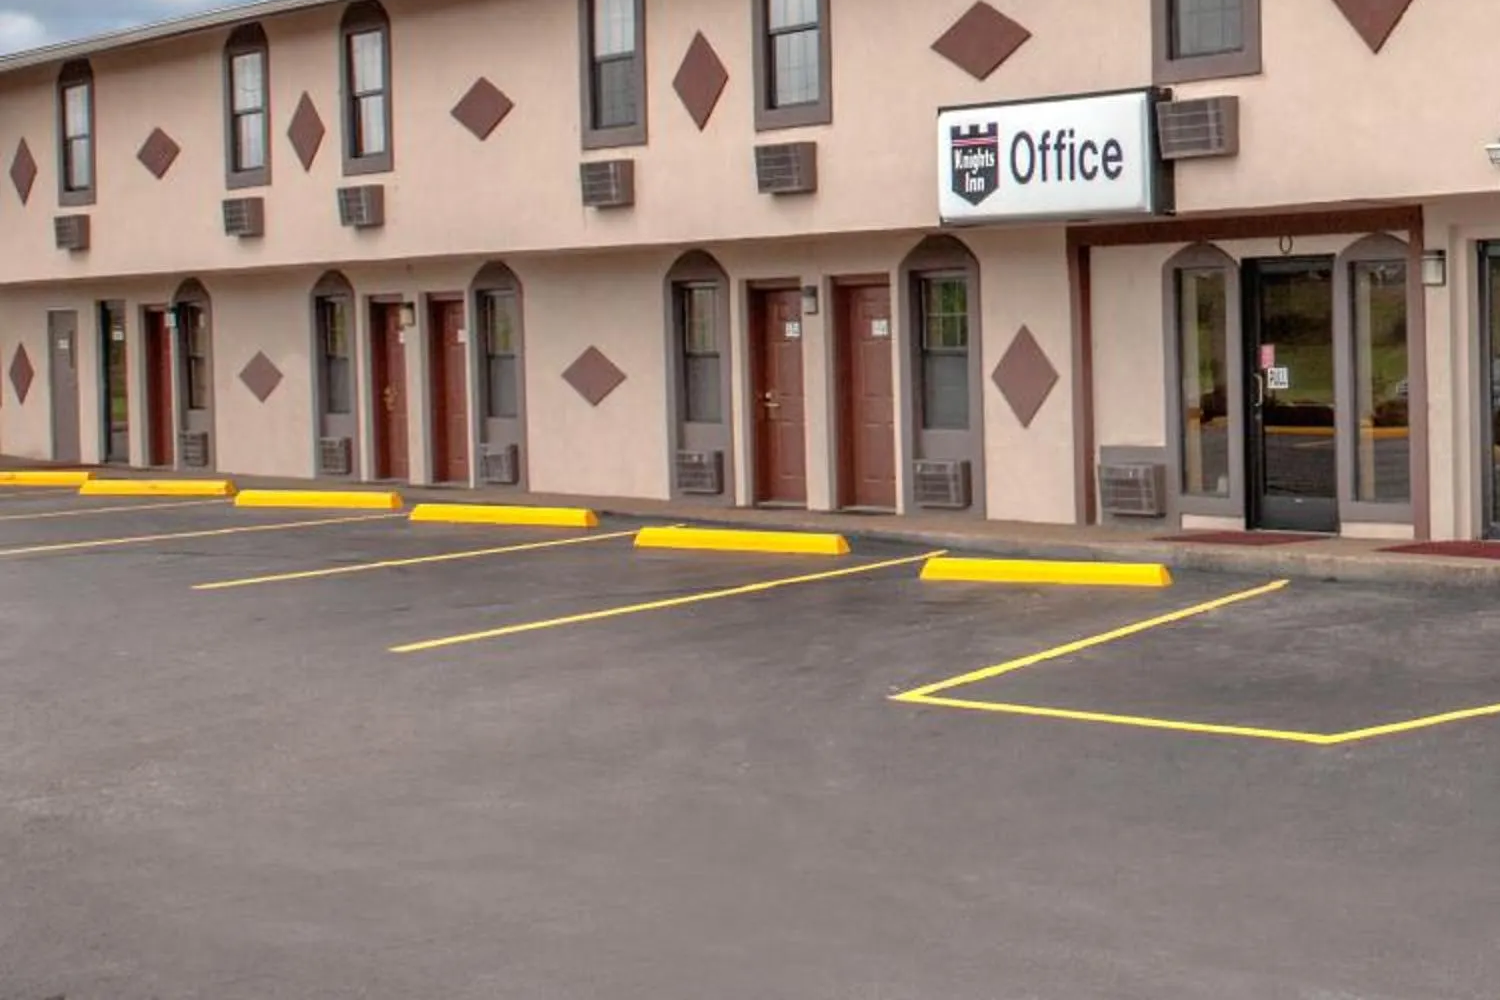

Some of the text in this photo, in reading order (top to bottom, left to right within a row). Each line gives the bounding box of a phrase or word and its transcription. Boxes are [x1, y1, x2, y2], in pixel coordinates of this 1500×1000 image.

[954, 147, 995, 174] Knights
[1010, 128, 1123, 184] Office
[965, 172, 985, 193] Inn
